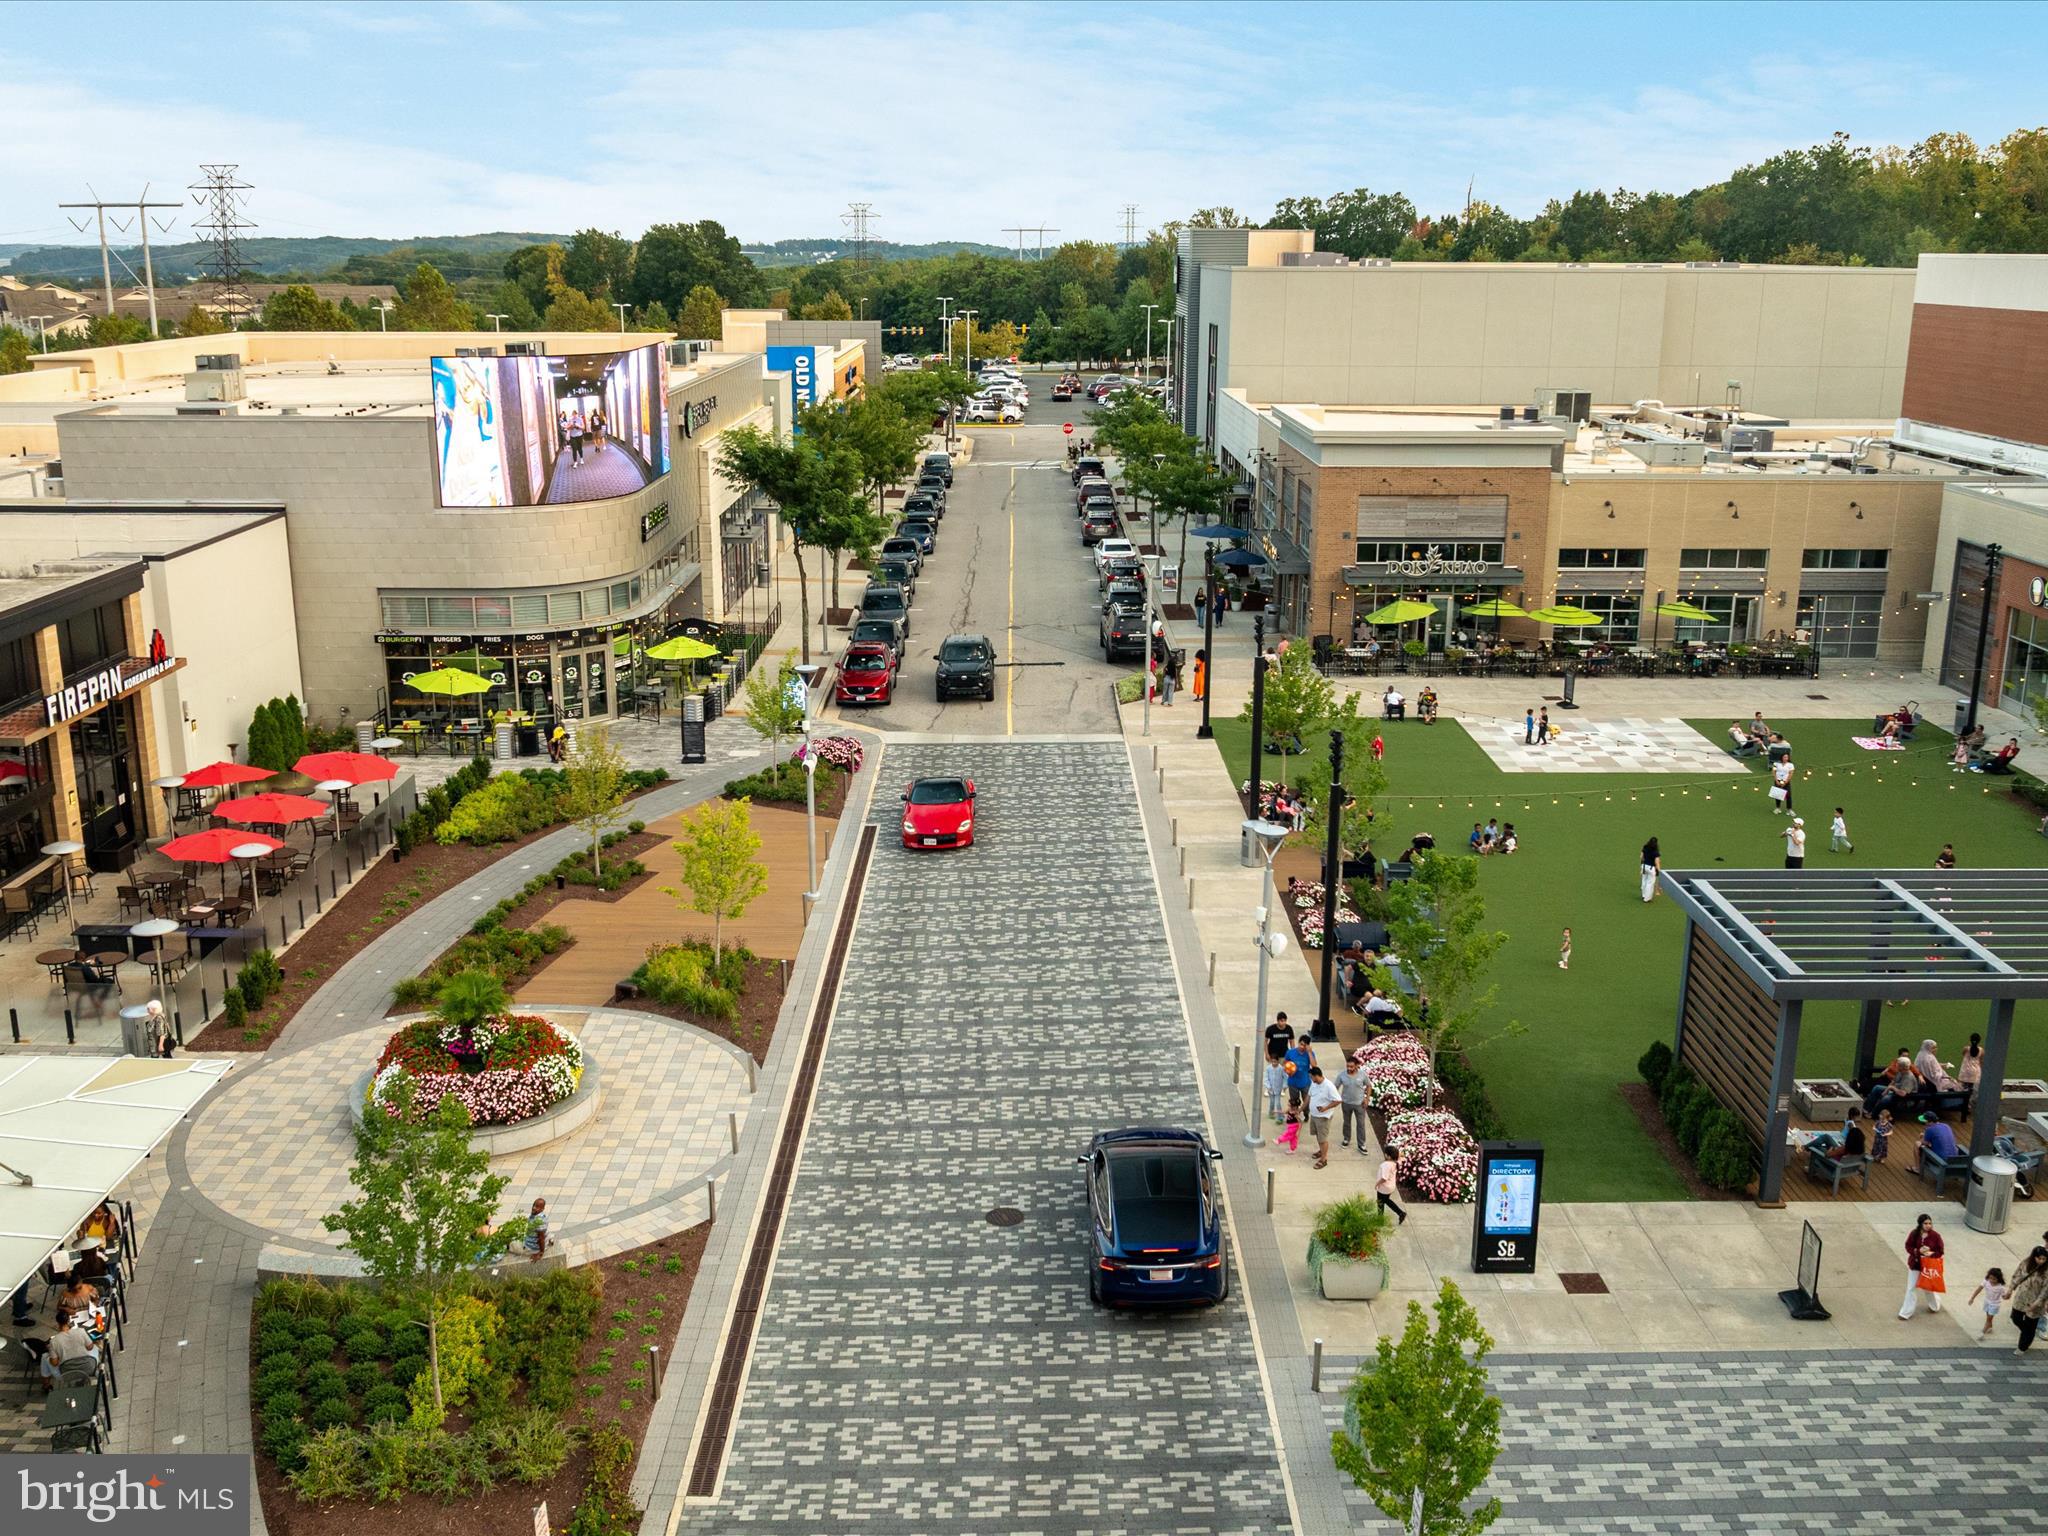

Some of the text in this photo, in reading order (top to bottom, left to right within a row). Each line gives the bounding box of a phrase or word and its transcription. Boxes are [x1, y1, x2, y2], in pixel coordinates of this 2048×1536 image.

[795, 355, 810, 386] OLD
[1386, 560, 1489, 576] DOK KHAO
[124, 670, 148, 690] KOREAN
[147, 664, 160, 679] BBQ
[46, 664, 123, 727] FIREPAN
